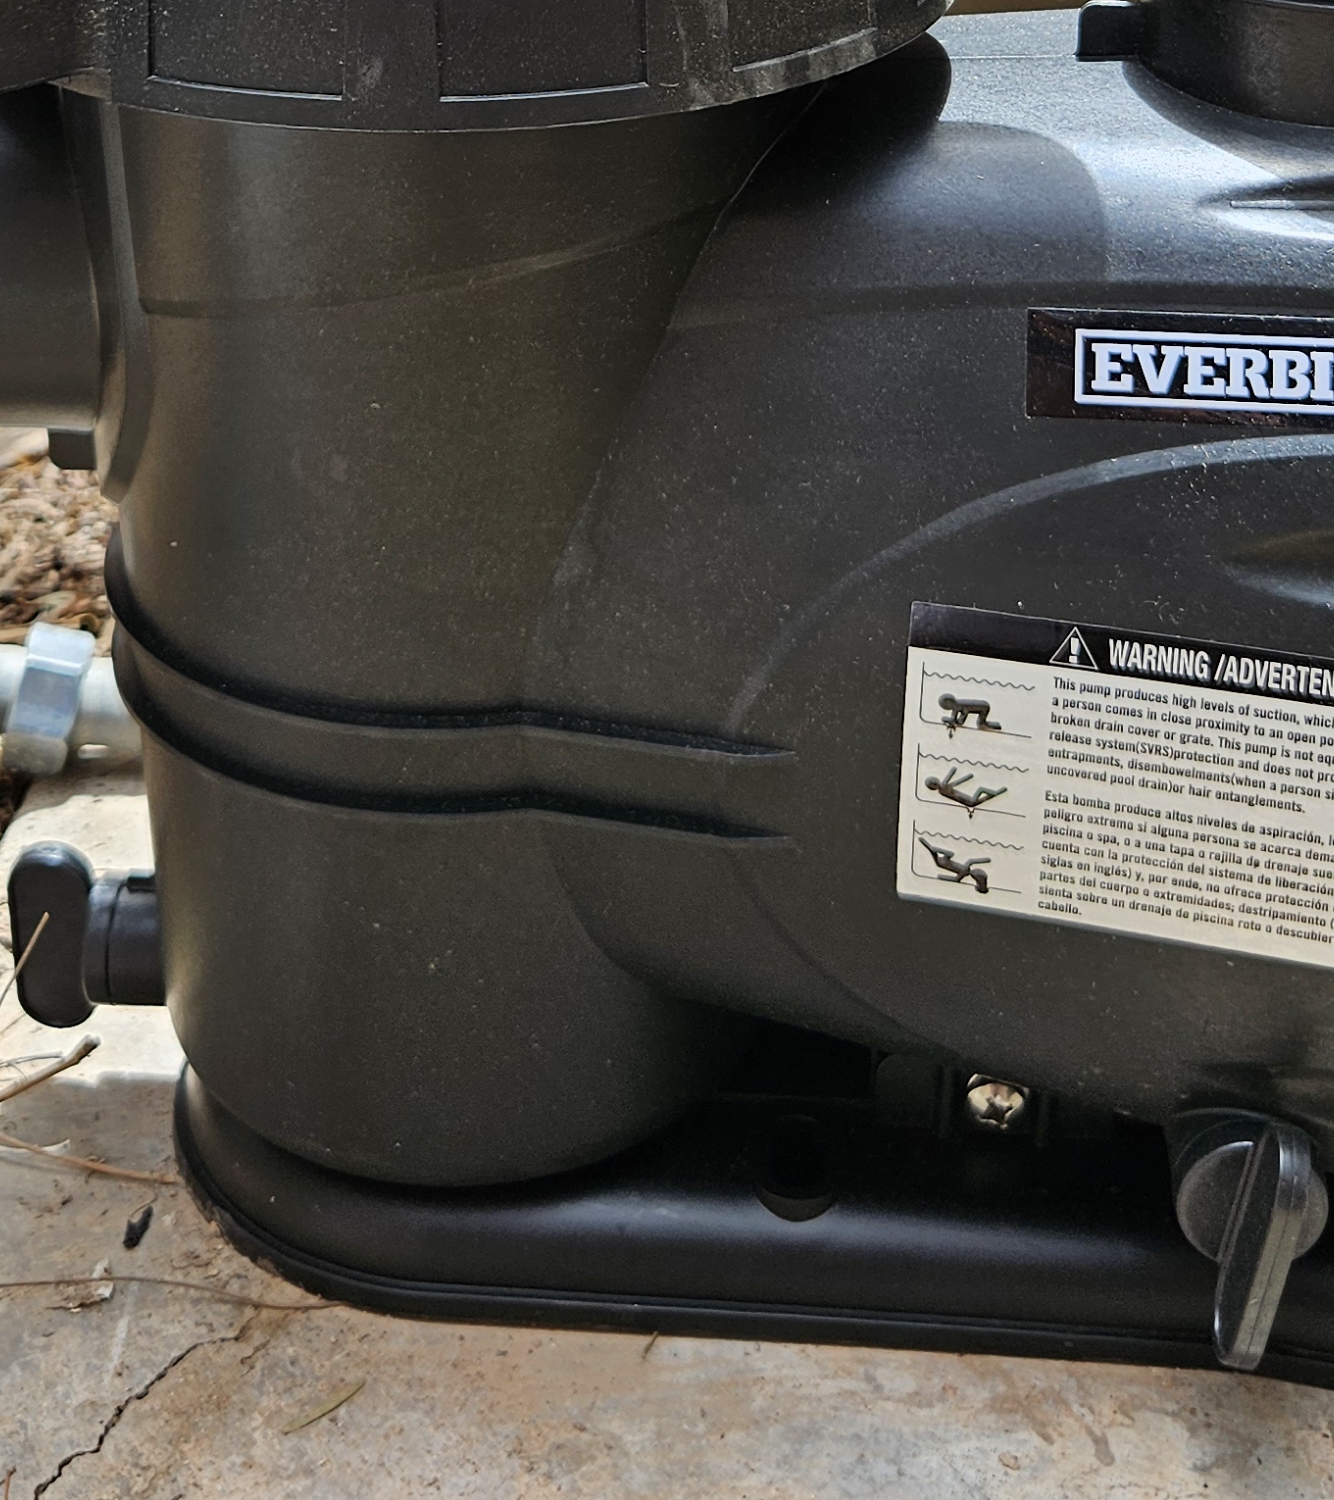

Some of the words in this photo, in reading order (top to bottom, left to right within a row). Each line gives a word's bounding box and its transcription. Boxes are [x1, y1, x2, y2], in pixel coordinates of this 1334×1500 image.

[1108, 638, 1210, 680] WARNING
[1051, 696, 1060, 707] a
[1061, 698, 1102, 713] person
[1104, 704, 1144, 719] comes
[1146, 707, 1158, 721] in
[1160, 710, 1192, 726] close
[1194, 717, 1251, 737] proximity
[1253, 724, 1266, 737] to
[1268, 728, 1284, 740] an
[1286, 731, 1316, 745] open
[1053, 675, 1076, 692] This
[1079, 682, 1111, 699] pump
[1114, 687, 1169, 705] produces
[1171, 692, 1197, 710] high
[1199, 697, 1235, 714] levels
[1237, 703, 1251, 717] of
[1252, 707, 1301, 726] suction,
[1048, 729, 1092, 746] release
[1095, 737, 1235, 768] system(SVRS)protection
[1237, 759, 1260, 772] and
[1262, 760, 1292, 777] does
[1294, 767, 1315, 781] not
[1050, 711, 1091, 729] broken
[1093, 718, 1124, 734] drain
[1127, 725, 1161, 739] cover
[1163, 730, 1177, 742] or
[1178, 732, 1214, 748] grate.
[1217, 735, 1242, 751] This
[1244, 742, 1278, 759] pump
[1280, 744, 1291, 759] is
[1293, 750, 1314, 763] not
[1046, 764, 1107, 783] uncovered
[1109, 774, 1135, 787] pool
[1137, 776, 1186, 795] drain)or
[1188, 783, 1213, 799] hair
[1214, 789, 1306, 814] entanglements.
[1047, 747, 1124, 770] entrapments,
[1269, 781, 1277, 792] a
[1279, 783, 1321, 799] person
[1043, 808, 1084, 823] peligro
[1086, 815, 1134, 831] extremo
[1137, 821, 1148, 834] si
[1149, 824, 1189, 840] alguna
[1192, 832, 1240, 848] persona
[1243, 841, 1257, 851] se
[1259, 843, 1302, 858] acerca
[1044, 789, 1069, 805] Esta
[1072, 793, 1111, 811] bomba
[1113, 802, 1162, 819] produce
[1164, 809, 1194, 825] altos
[1196, 814, 1238, 832] niveles
[1241, 821, 1256, 834] de
[1258, 825, 1325, 847] aspiración,
